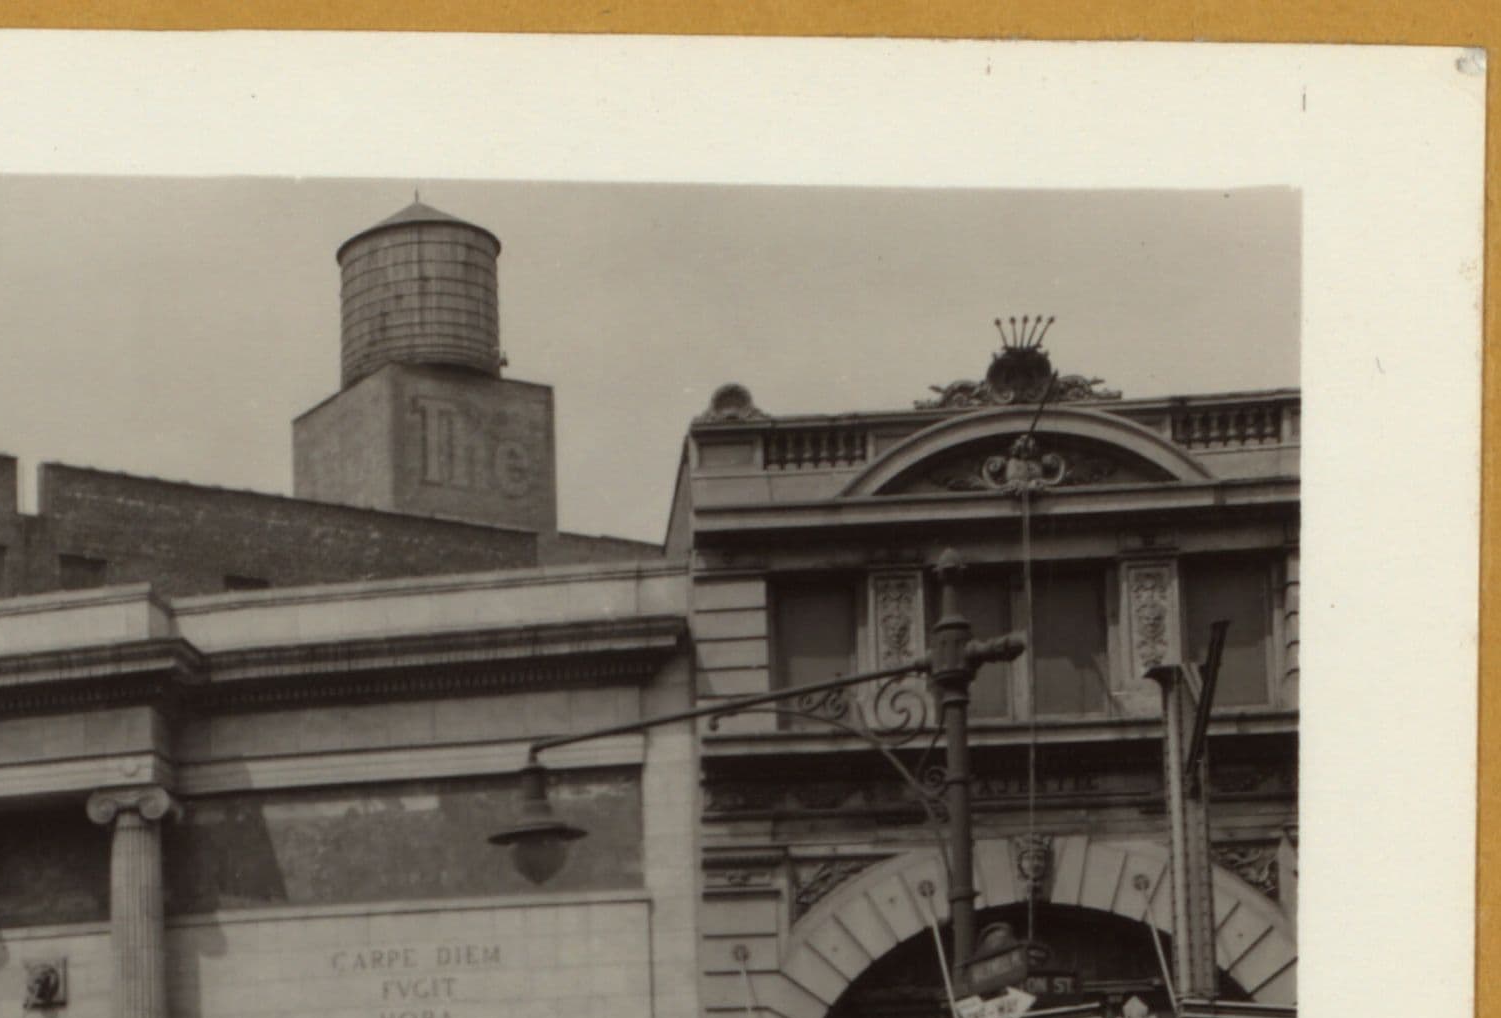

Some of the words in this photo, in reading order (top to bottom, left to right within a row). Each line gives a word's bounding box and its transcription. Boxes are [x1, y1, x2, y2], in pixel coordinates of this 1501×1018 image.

[410, 393, 530, 500] The
[330, 947, 419, 971] CARPE
[436, 943, 502, 968] DIEM
